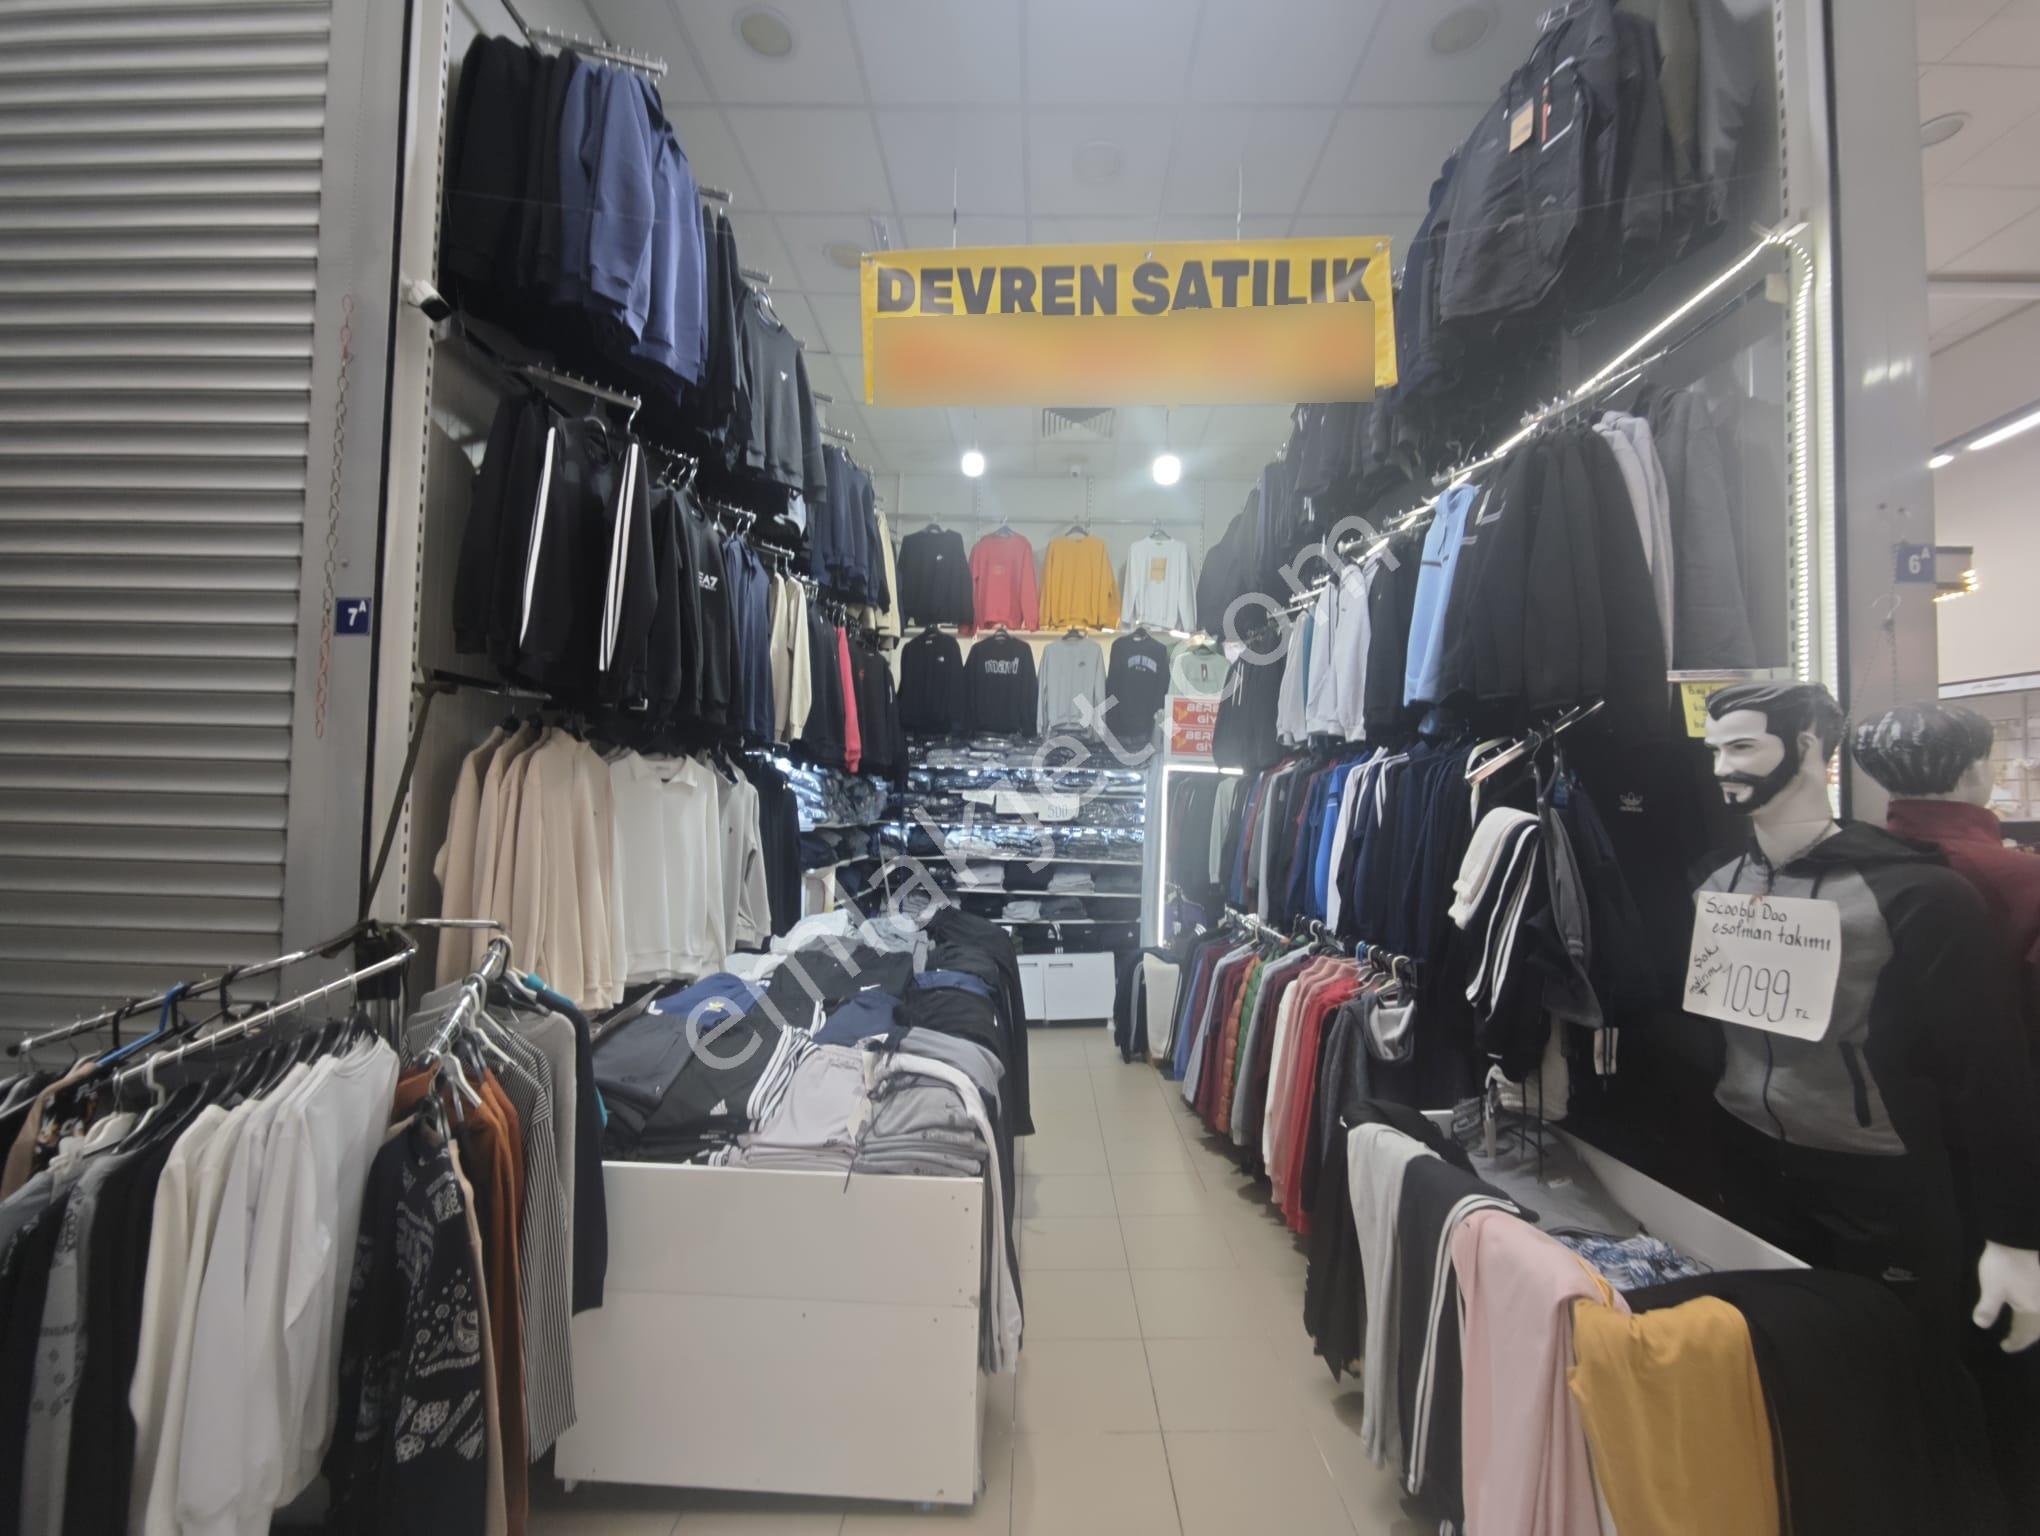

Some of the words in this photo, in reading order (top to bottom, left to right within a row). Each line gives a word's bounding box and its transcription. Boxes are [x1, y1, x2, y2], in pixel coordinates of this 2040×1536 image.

[877, 264, 1118, 316] DEVREN
[1132, 257, 1373, 315] SATILIK
[1705, 897, 1755, 923] Scooby
[1762, 903, 1788, 922] Doo
[1723, 962, 1791, 1022] 1099
[1794, 1008, 1810, 1019] TL
